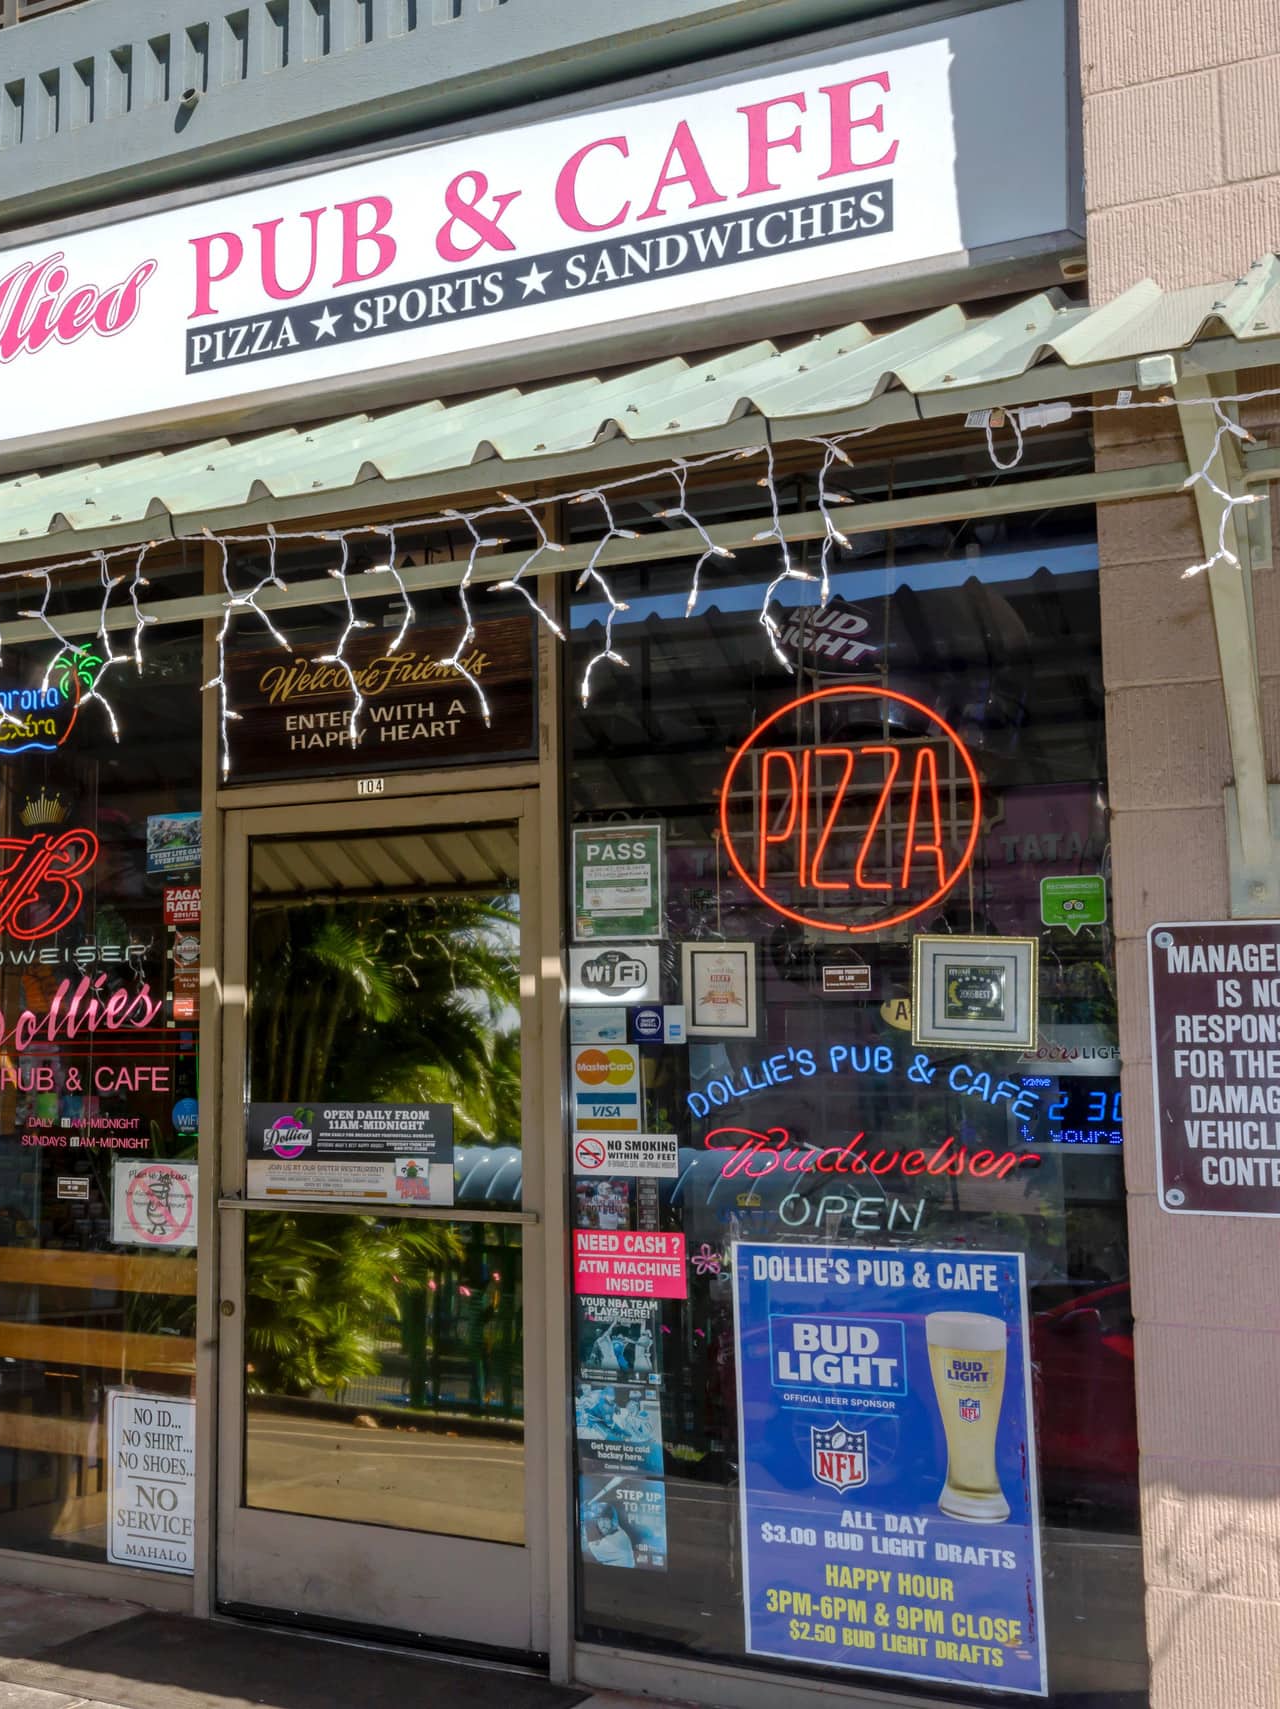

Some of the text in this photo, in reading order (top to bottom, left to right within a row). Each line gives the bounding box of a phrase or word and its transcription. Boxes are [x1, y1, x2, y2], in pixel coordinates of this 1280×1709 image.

[188, 71, 902, 317] PUB & CAFE
[188, 189, 885, 370] PIZZA SPORTS SANDWICHES
[370, 702, 434, 722] WITH
[447, 699, 466, 715] A
[381, 719, 461, 742] HEART
[360, 780, 383, 793] 104
[759, 746, 947, 889] PIZZA
[587, 842, 646, 861] PASS
[167, 889, 201, 900] ZAGA
[1168, 944, 1280, 973] MANAGE
[1217, 979, 1242, 1008] IS
[1175, 1015, 1280, 1043] RESPON
[577, 1063, 633, 1072] MasterCard
[1174, 1049, 1280, 1079] FOR THE
[1, 1067, 170, 1092] PUB & CAFE
[686, 1045, 1040, 1122] DOLLIE'S PUB & CAFE
[323, 1110, 430, 1121] OPEN DAILY FROM
[592, 1106, 621, 1117] VISA
[28, 1117, 54, 1128] DAILY
[328, 1120, 425, 1131] 11AM-MIDNIGHT
[21, 1136, 67, 1147] SUNDAYS
[265, 1129, 312, 1147] Dollies
[607, 1140, 676, 1152] NO SMOKING
[608, 1152, 676, 1161] WITHIN 20 FEET
[704, 1127, 1042, 1180] Budweiser
[779, 1193, 926, 1231] OPEN
[577, 1234, 680, 1254] NEED CASH ?
[579, 1260, 681, 1277] ATM MACHINE
[753, 1256, 999, 1292] DOLLIE'S PUB & CAFE
[606, 1278, 654, 1292] INSIDE
[580, 1297, 658, 1310] YOUR NBA TEAM
[588, 1306, 650, 1319] PLAYS HERE!
[793, 1323, 879, 1355] BUD
[778, 1352, 897, 1387] LIGHT
[953, 1360, 983, 1371] BUD
[948, 1370, 989, 1382] LIGHT
[783, 1393, 895, 1409] OFFICIAL BEER SPONSOR
[134, 1408, 153, 1425] NO
[122, 1430, 140, 1447] NO
[591, 1442, 650, 1453] Get your ice cold
[118, 1451, 138, 1469] NO
[819, 1452, 862, 1482] NFL
[136, 1485, 178, 1511] NO
[616, 1489, 662, 1502] STEP UP
[623, 1502, 638, 1512] TO
[117, 1509, 192, 1536] SERVICE
[841, 1510, 928, 1535] ALL DAY
[125, 1543, 187, 1563] MAHALO
[761, 1522, 1016, 1570] $3.00 BUD LIGHT DRAFTS
[826, 1564, 954, 1601] HAPPY HOUR
[766, 1589, 1022, 1644] 3PM-6PM & 9PM CLOSE
[789, 1619, 1004, 1667] $2.50 BUD LIGHT DRAFTS
